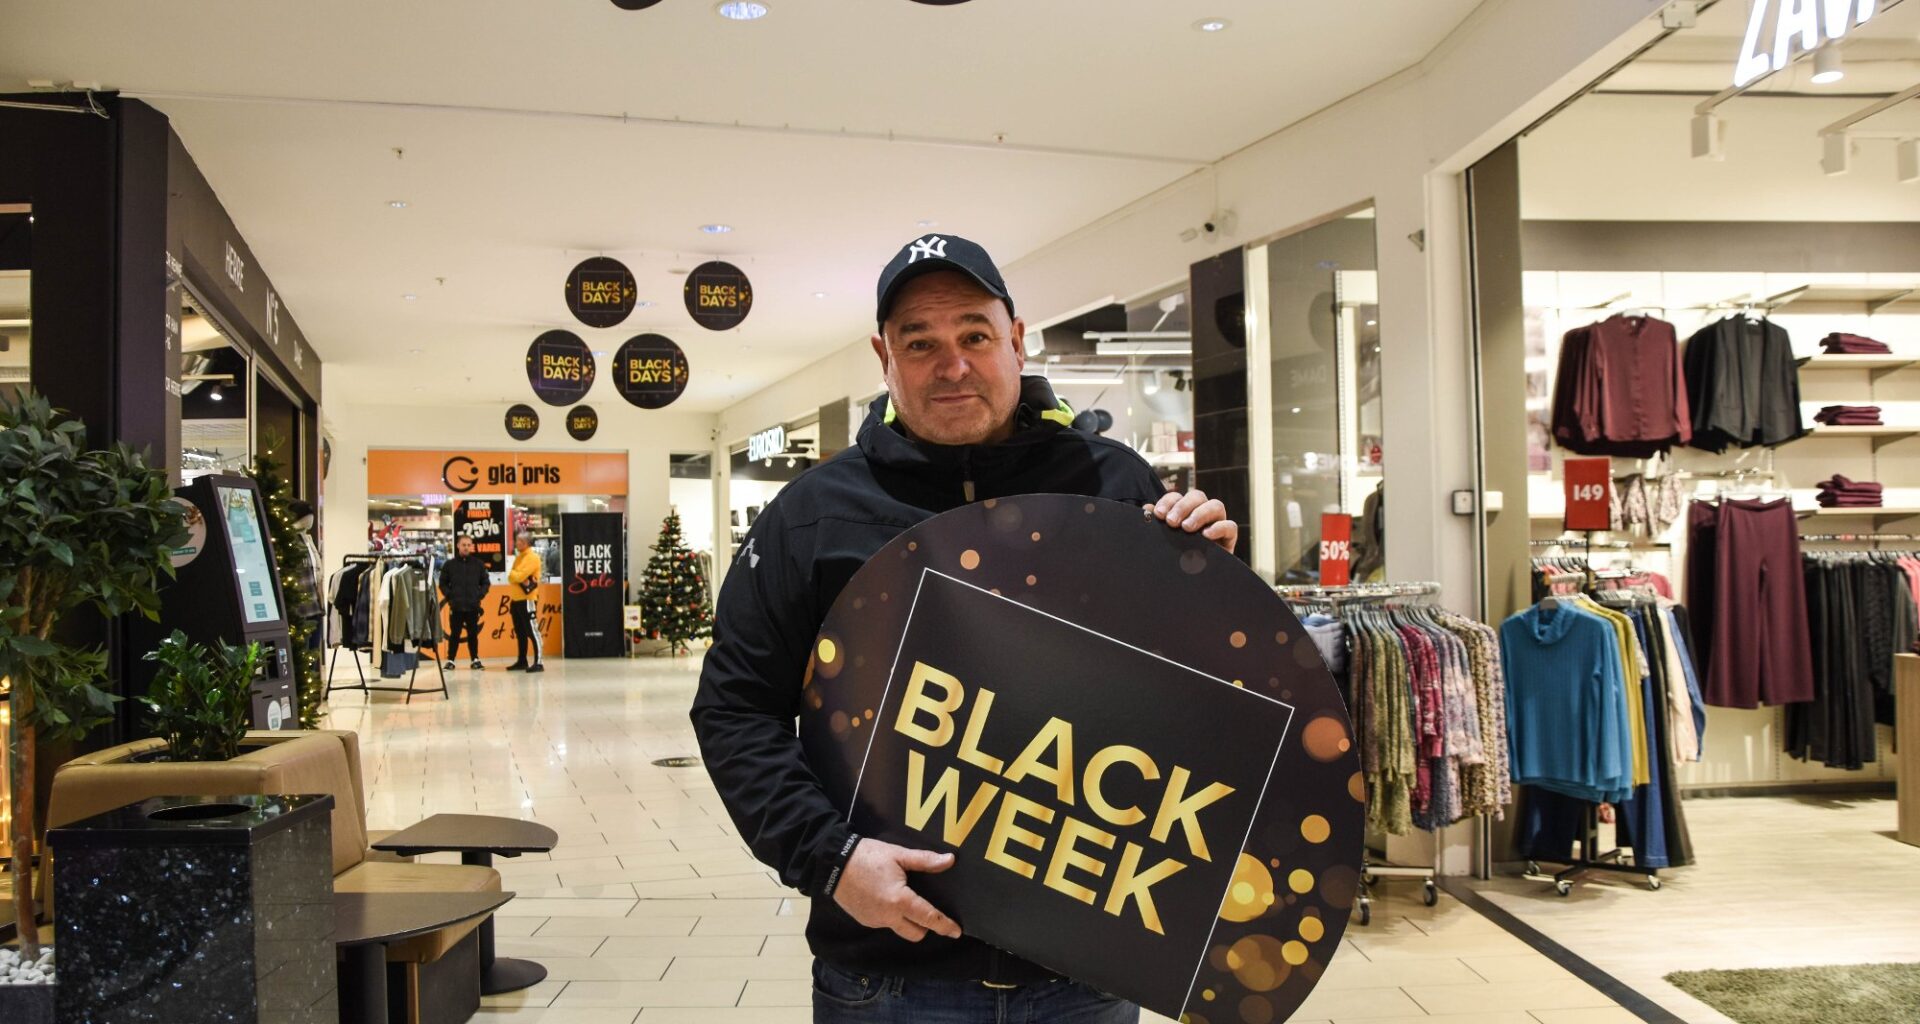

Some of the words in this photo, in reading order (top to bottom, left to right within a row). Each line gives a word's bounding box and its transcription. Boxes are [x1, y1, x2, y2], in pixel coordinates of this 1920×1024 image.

[908, 235, 947, 263] NY
[225, 240, 244, 293] HERRE
[582, 281, 620, 292] BLACK
[700, 284, 736, 296] BLACK
[582, 291, 621, 304] DAYS
[700, 294, 737, 307] DAYS
[543, 354, 580, 368] BLACK
[630, 359, 671, 371] BLACK
[543, 366, 580, 382] DAYS
[630, 370, 672, 383] DAYS
[512, 421, 531, 429] DAYS
[1574, 484, 1604, 501] 149
[468, 501, 490, 509] BLACK
[467, 509, 491, 518] FRIDAY
[574, 544, 612, 559] BLACK
[1320, 541, 1350, 560] 50%
[574, 559, 612, 574] WEEK
[568, 572, 615, 594] Sale
[894, 661, 1236, 862] BLACK
[904, 750, 1188, 936] WEEK
